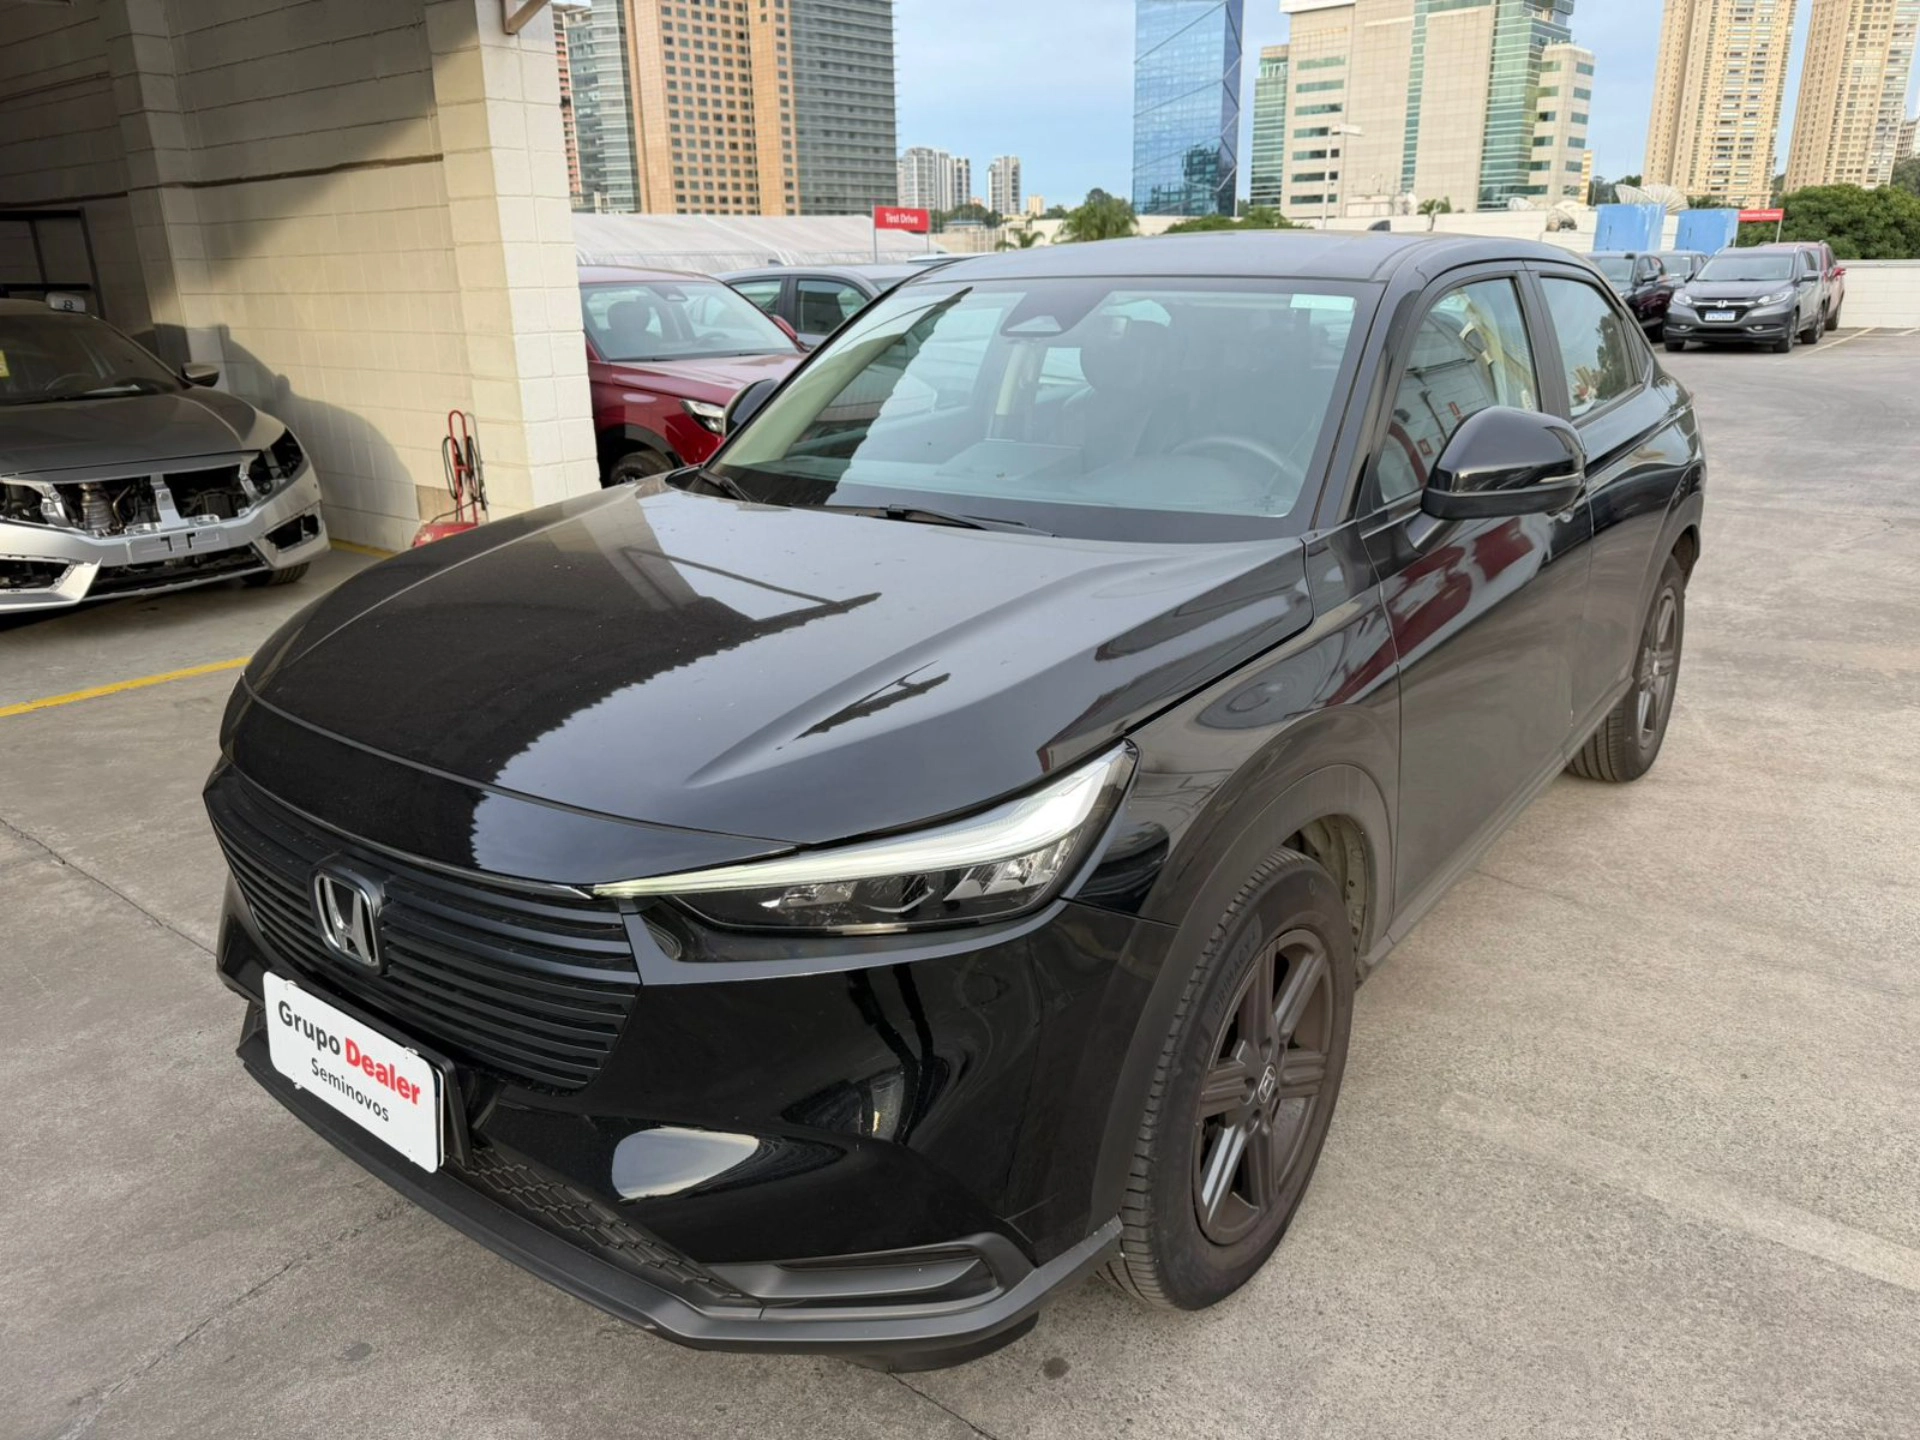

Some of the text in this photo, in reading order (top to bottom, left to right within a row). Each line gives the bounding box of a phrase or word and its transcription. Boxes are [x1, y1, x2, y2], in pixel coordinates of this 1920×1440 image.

[885, 212, 919, 225] Test Drive
[278, 1000, 421, 1105] Grupo Dealer
[311, 1057, 389, 1122] Seminovos
